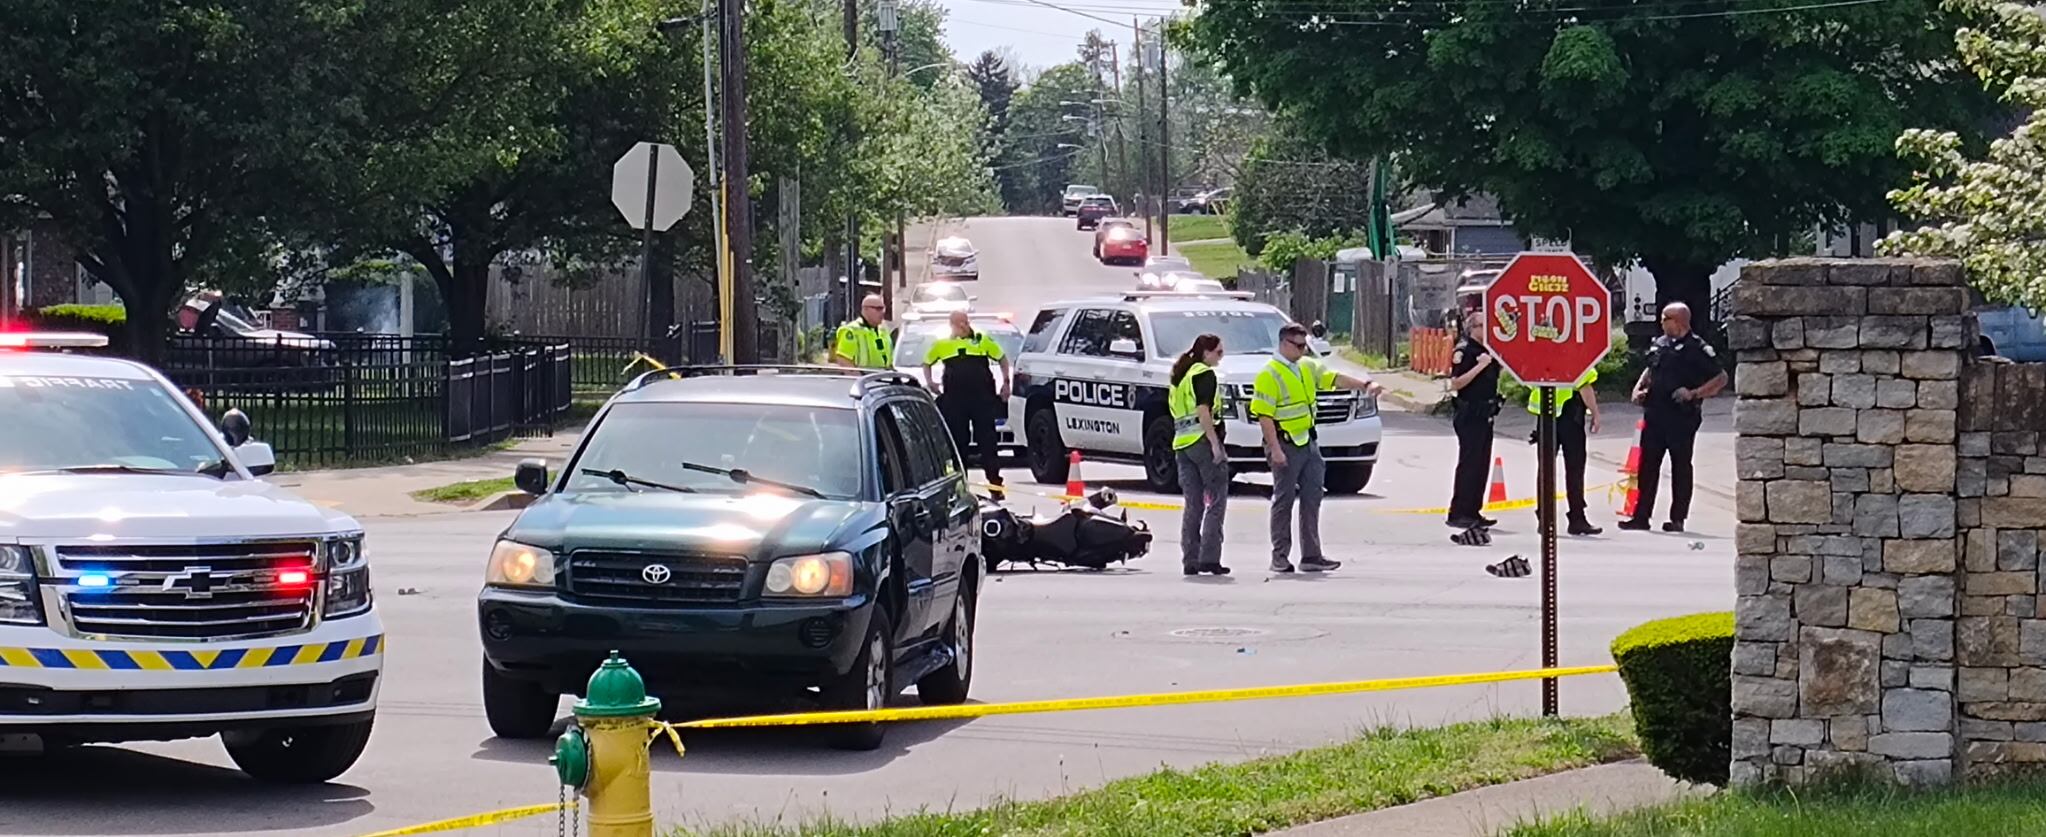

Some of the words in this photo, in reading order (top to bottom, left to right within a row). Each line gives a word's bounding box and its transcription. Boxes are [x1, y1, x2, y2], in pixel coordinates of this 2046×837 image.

[1493, 294, 1601, 343] STOP
[1055, 379, 1124, 407] POLICE
[1066, 417, 1120, 434] LEXINGTON
